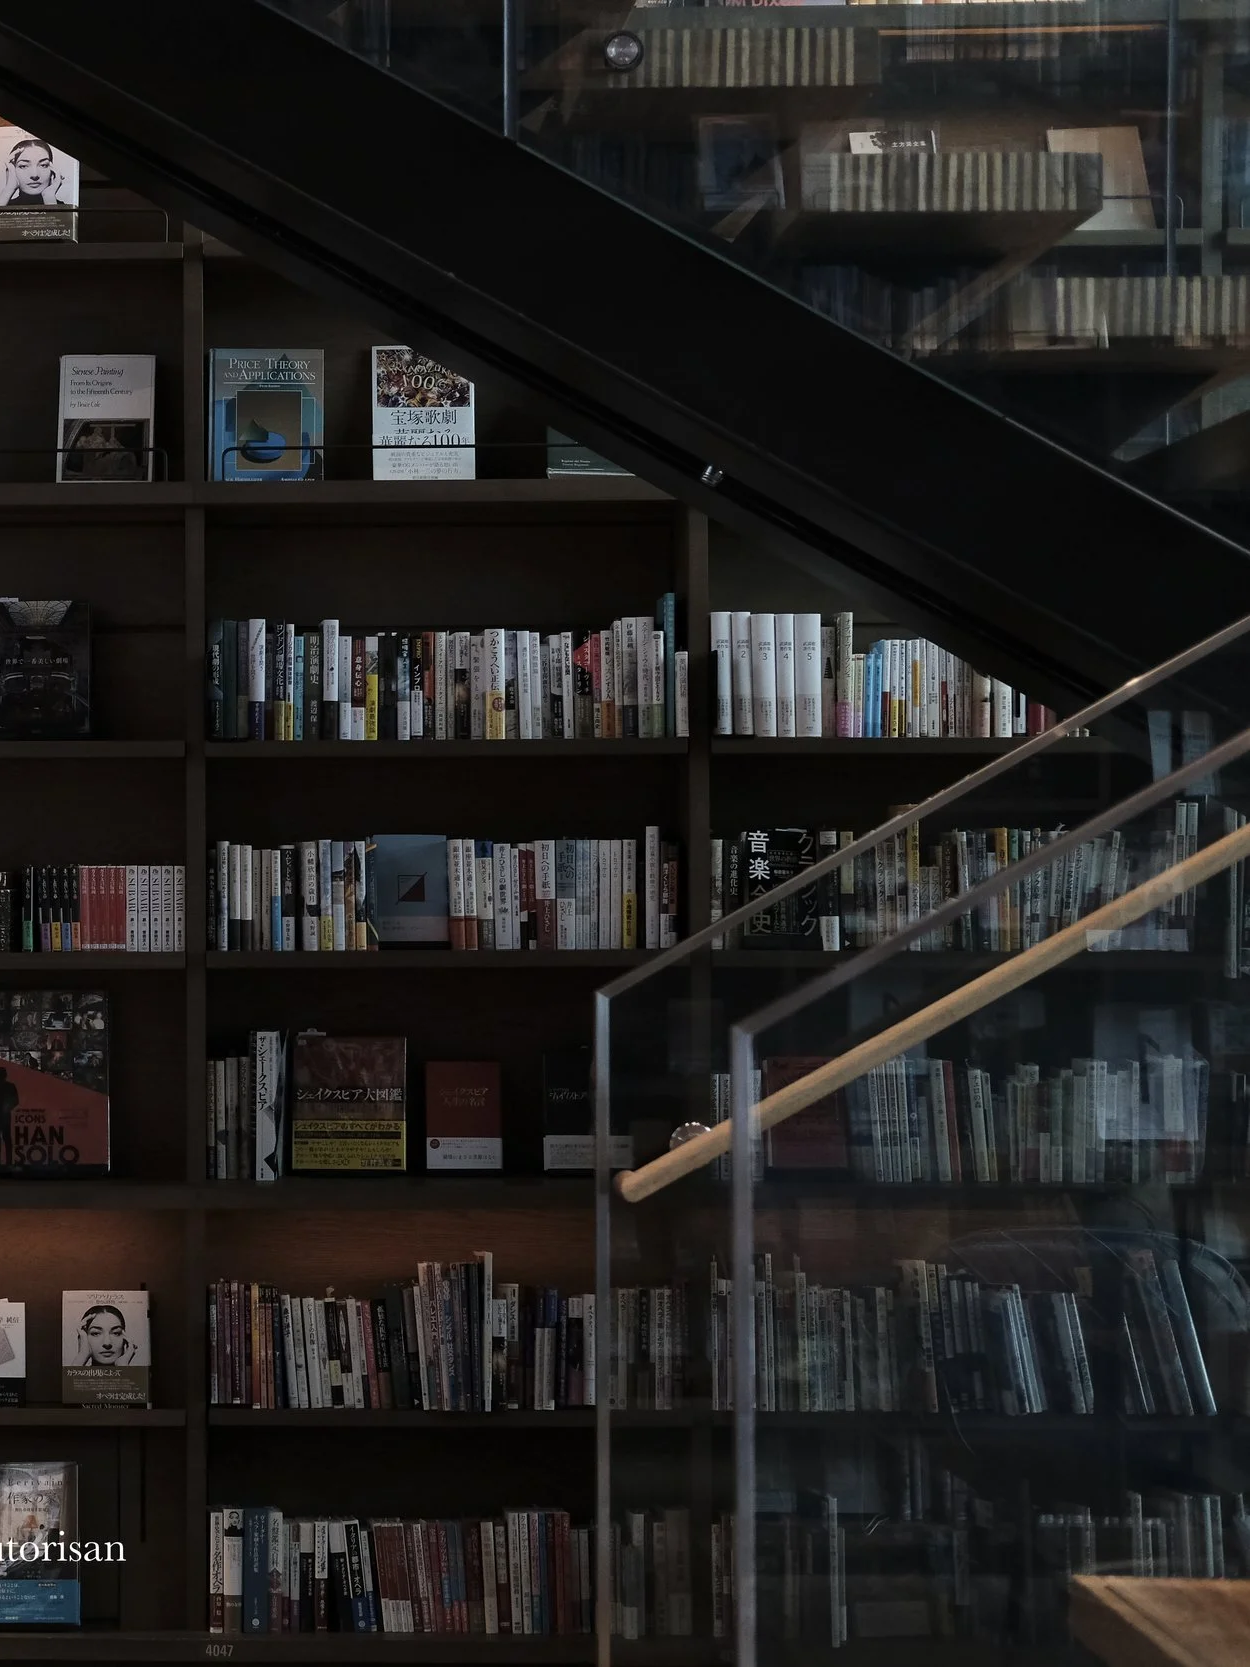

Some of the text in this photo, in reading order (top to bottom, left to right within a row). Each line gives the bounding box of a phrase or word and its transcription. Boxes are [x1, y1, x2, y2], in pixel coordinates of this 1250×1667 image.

[229, 357, 311, 371] PRICE THEORY
[95, 366, 124, 378] Painting
[224, 368, 316, 381] AND APPLICATIONS
[110, 388, 133, 396] Century
[390, 409, 457, 426] 宝塚歌劇
[490, 630, 500, 691] つかこうへい正伝
[720, 651, 725, 659] 1
[740, 651, 746, 659] 2
[762, 653, 768, 661] 3
[783, 653, 789, 661] 4
[806, 653, 812, 661] 5
[413, 664, 421, 691] インプロ
[541, 842, 551, 889] 初日への手紙
[565, 842, 575, 880] 初日への
[307, 850, 316, 903] 小幡欣治の歳月
[729, 846, 739, 896] 音楽の進化史
[258, 1035, 268, 1111] ザ・シェークスピア
[296, 1087, 403, 1101] シェイクスピア大図鑑
[14, 1113, 46, 1123] ICONS
[14, 1125, 64, 1145] HAN
[14, 1144, 78, 1164] SOLO
[95, 1392, 146, 1401] オペラは完成した!
[6, 1492, 58, 1507] 作家の家
[205, 1644, 234, 1657] 4047
